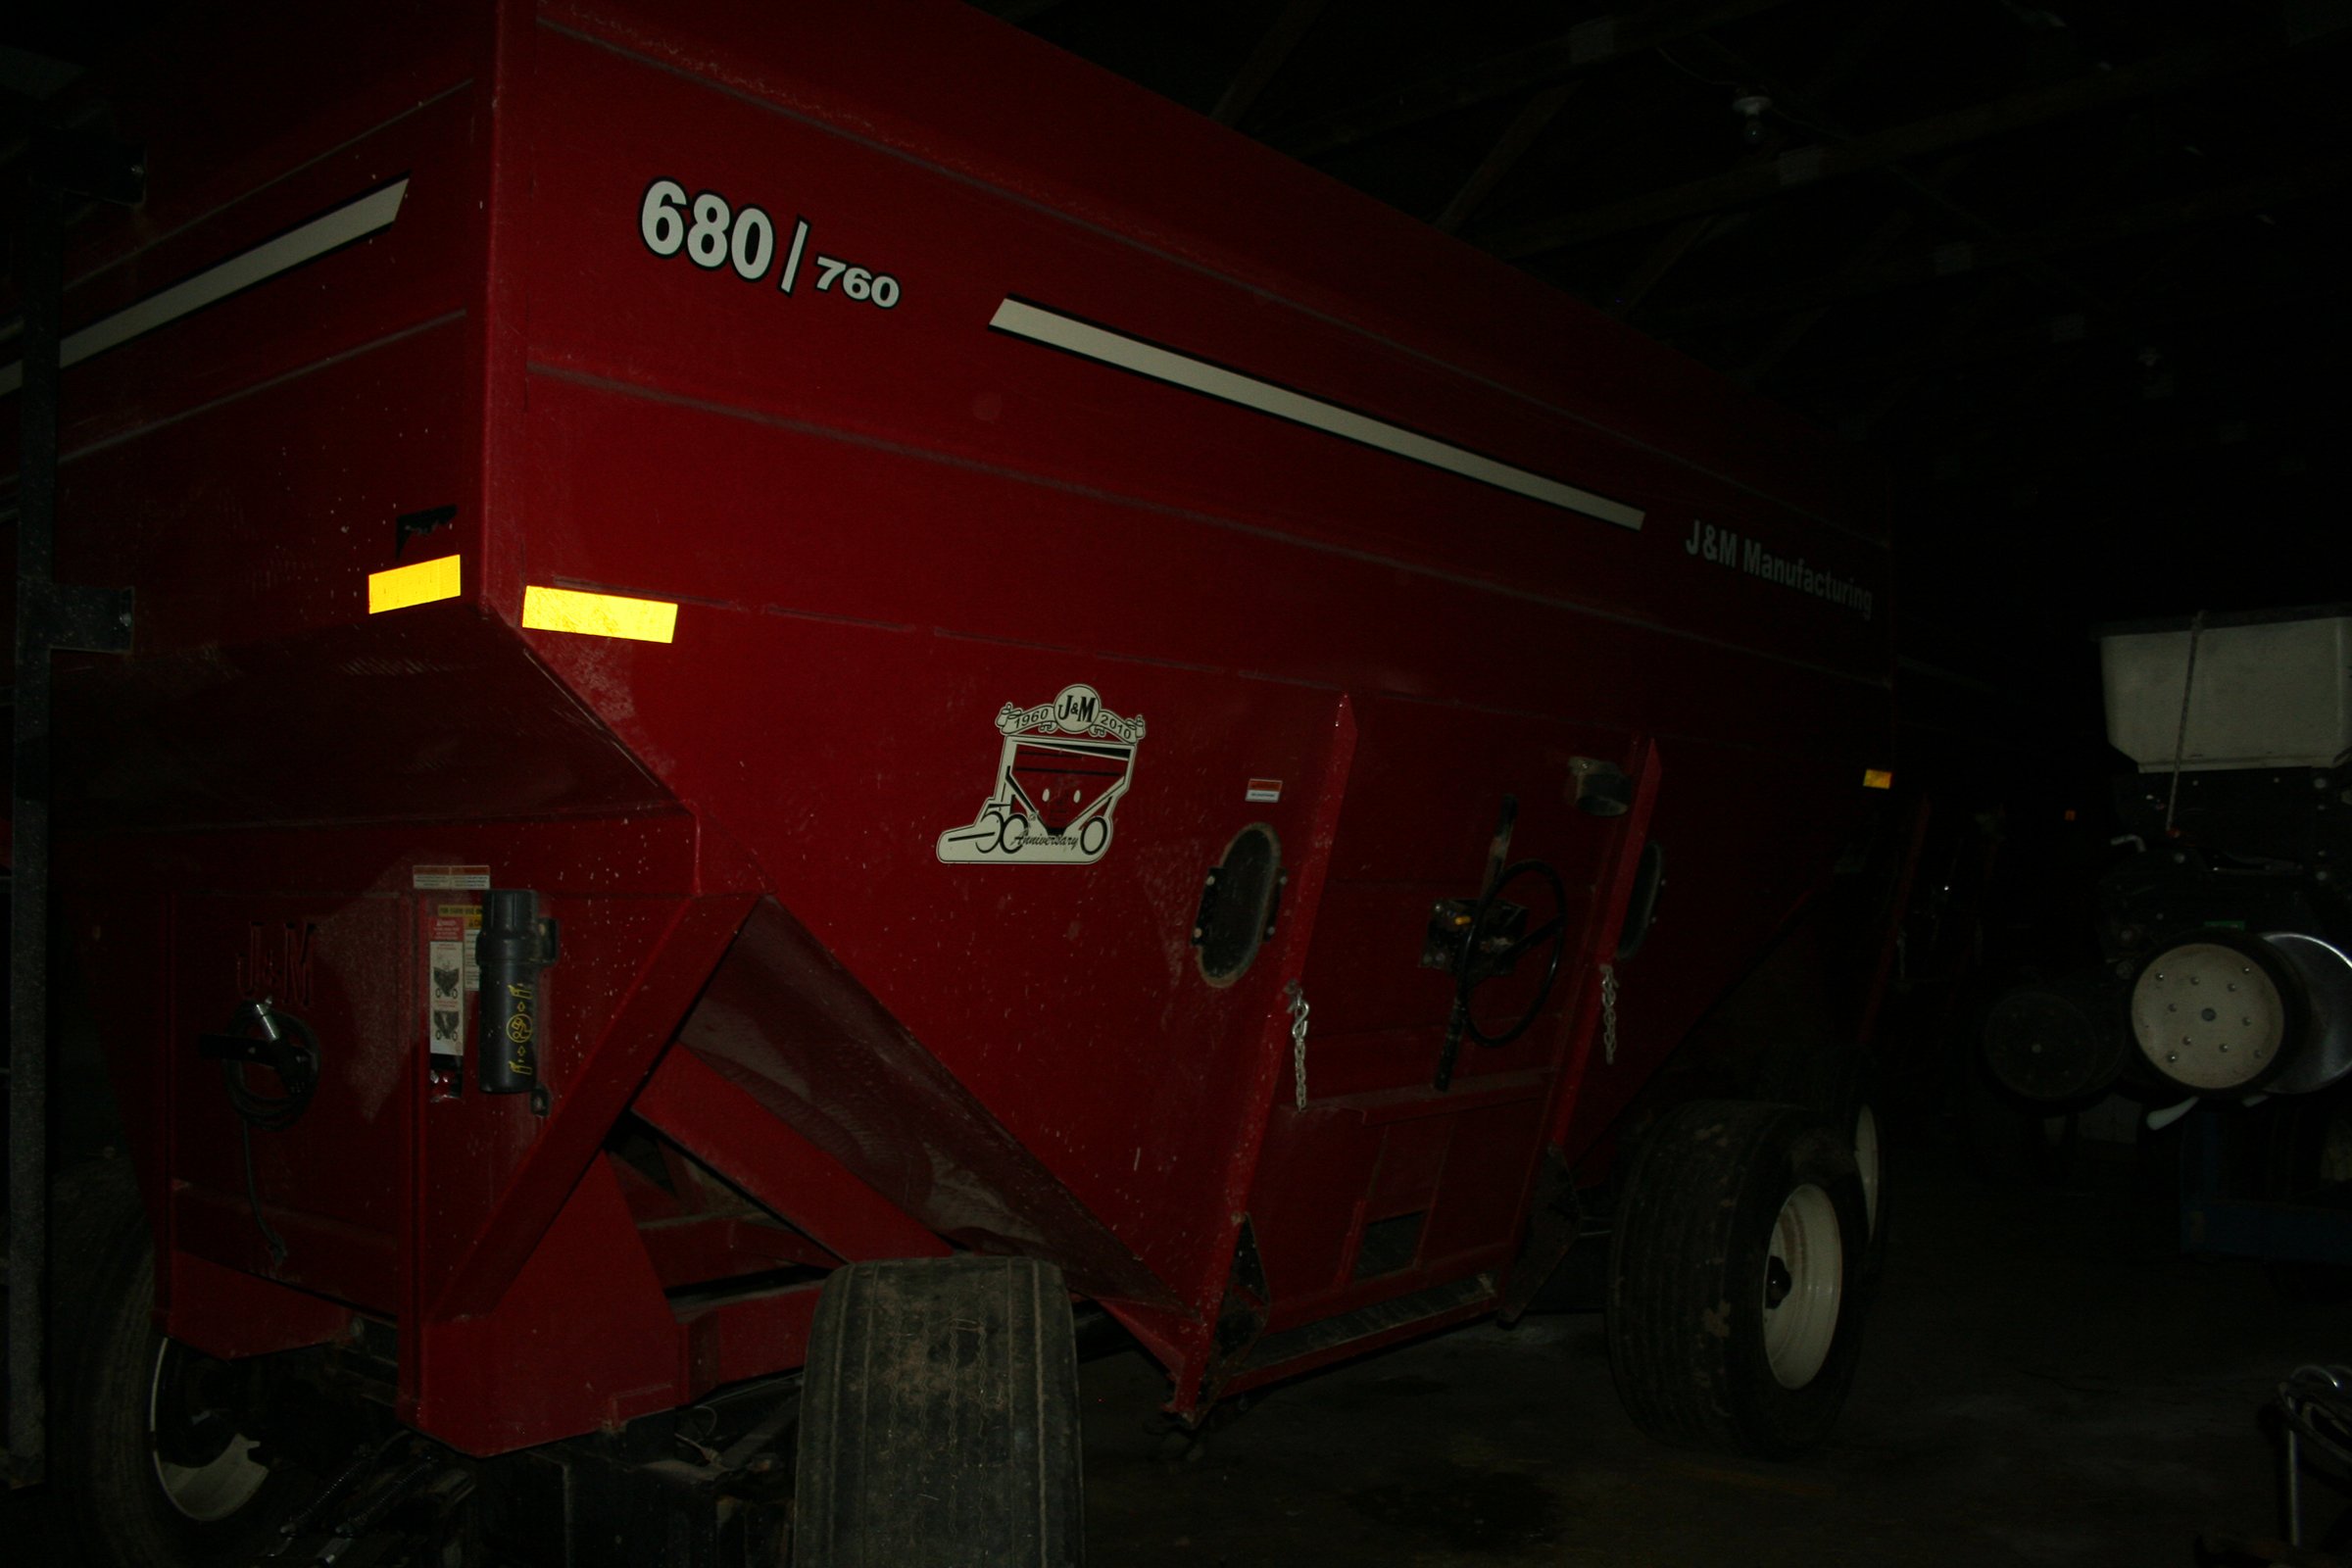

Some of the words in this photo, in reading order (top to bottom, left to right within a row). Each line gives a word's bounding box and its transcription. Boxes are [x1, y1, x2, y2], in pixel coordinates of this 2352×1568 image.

[1685, 517, 1738, 569] J&M
[1742, 538, 1874, 622] Manufacturing
[1013, 708, 1049, 730] 1960
[1057, 694, 1097, 723] J&M
[1101, 713, 1132, 741] 2010
[1009, 830, 1079, 851] Anniversary
